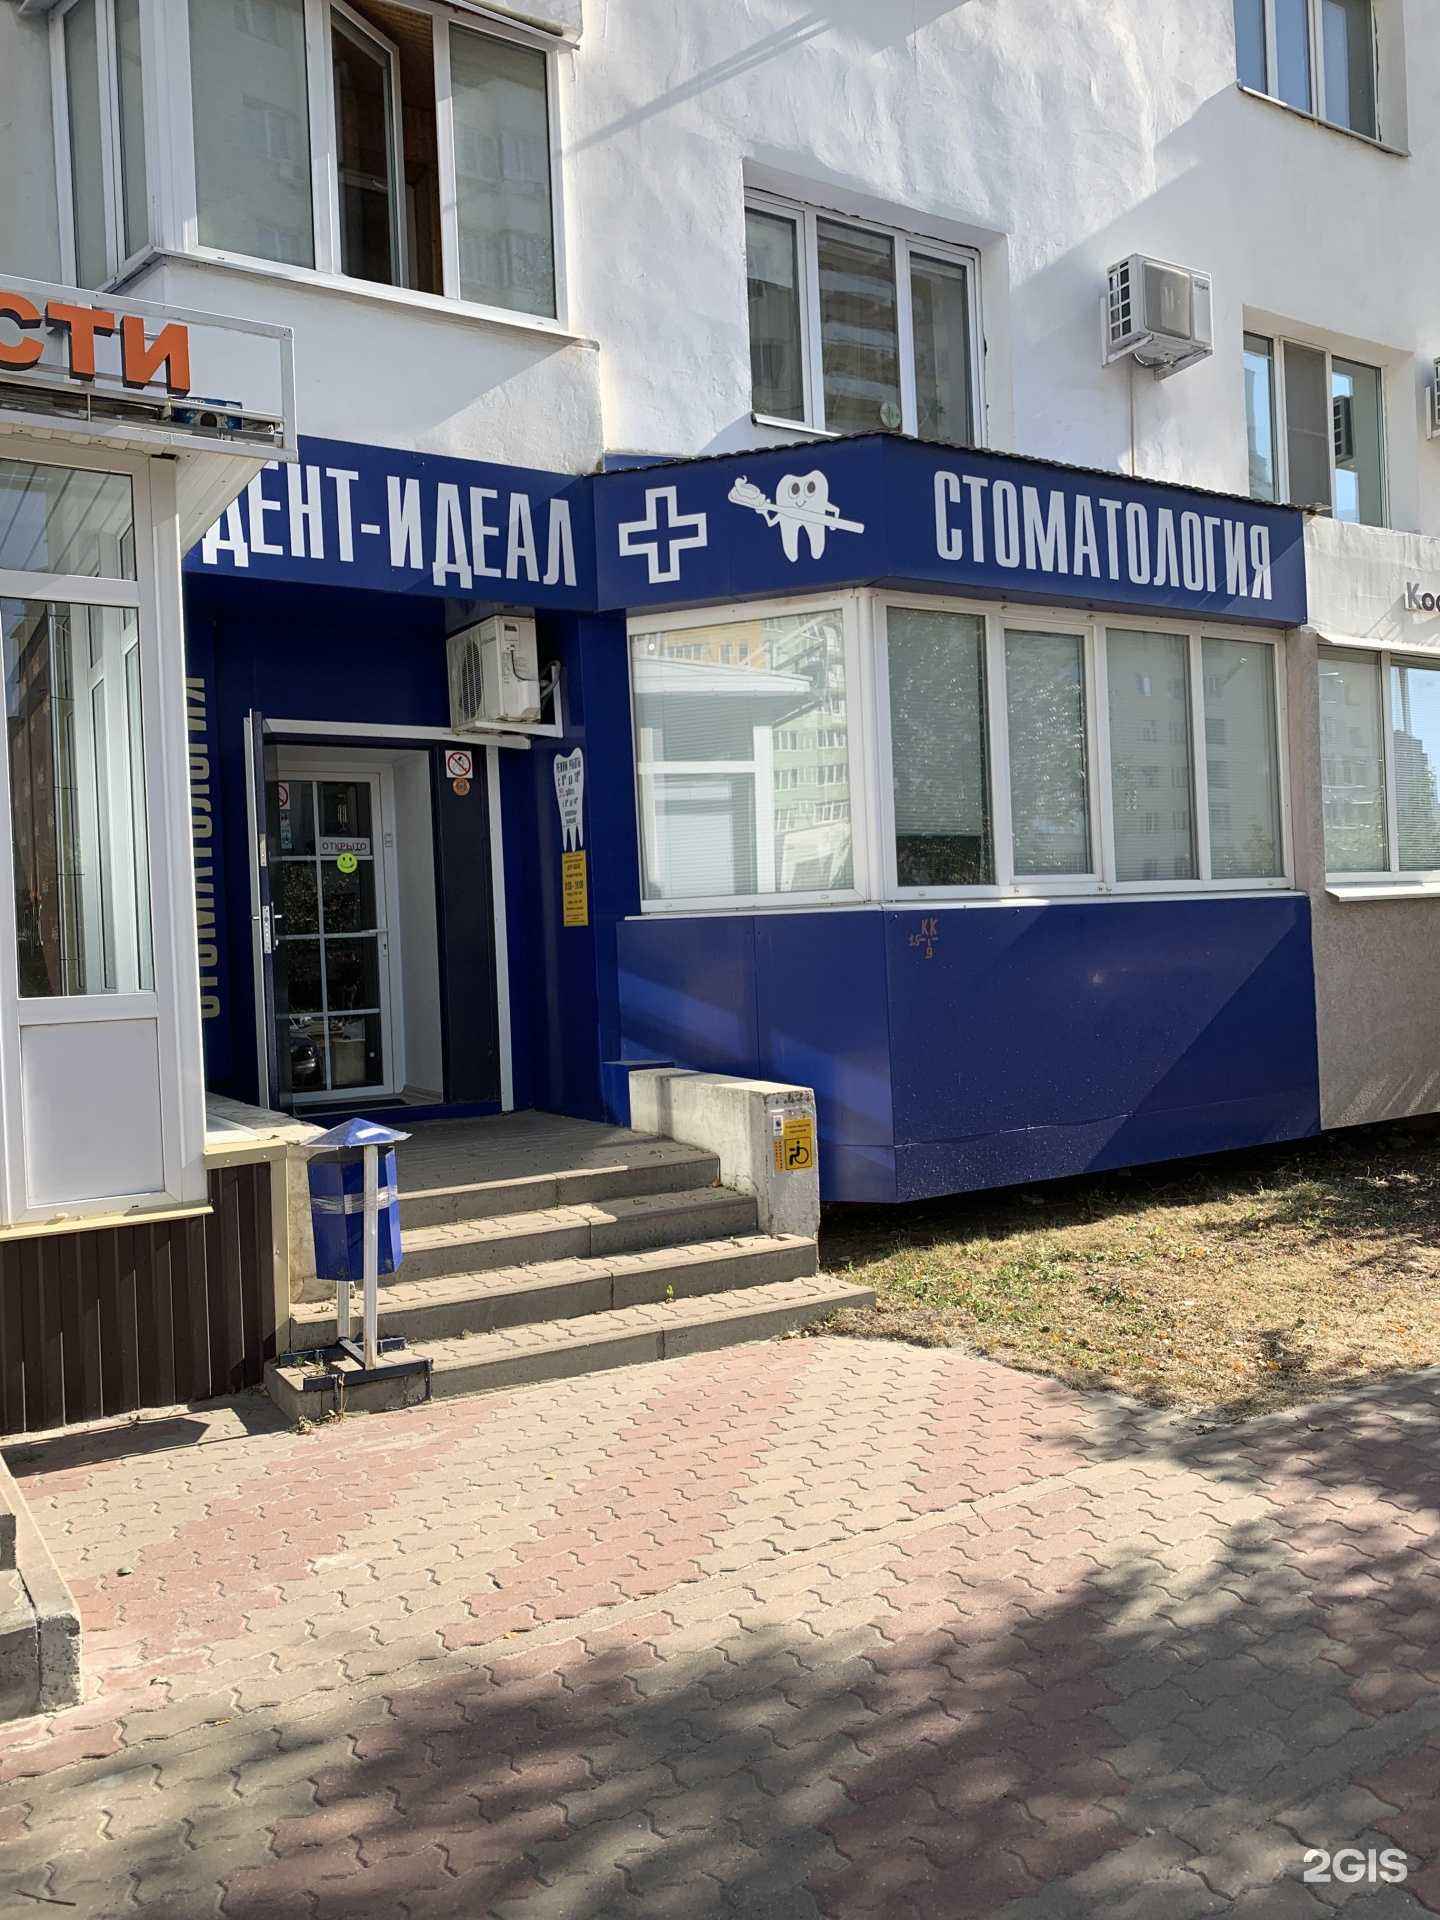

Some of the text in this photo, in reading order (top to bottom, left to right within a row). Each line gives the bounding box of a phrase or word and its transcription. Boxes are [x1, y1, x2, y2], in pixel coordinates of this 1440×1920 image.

[202, 460, 577, 589] ДЕНТ-ИДЕАЛ
[933, 470, 1273, 600] СТОМАТОЛОГИЯ
[322, 842, 367, 850] ОТКРЫТО
